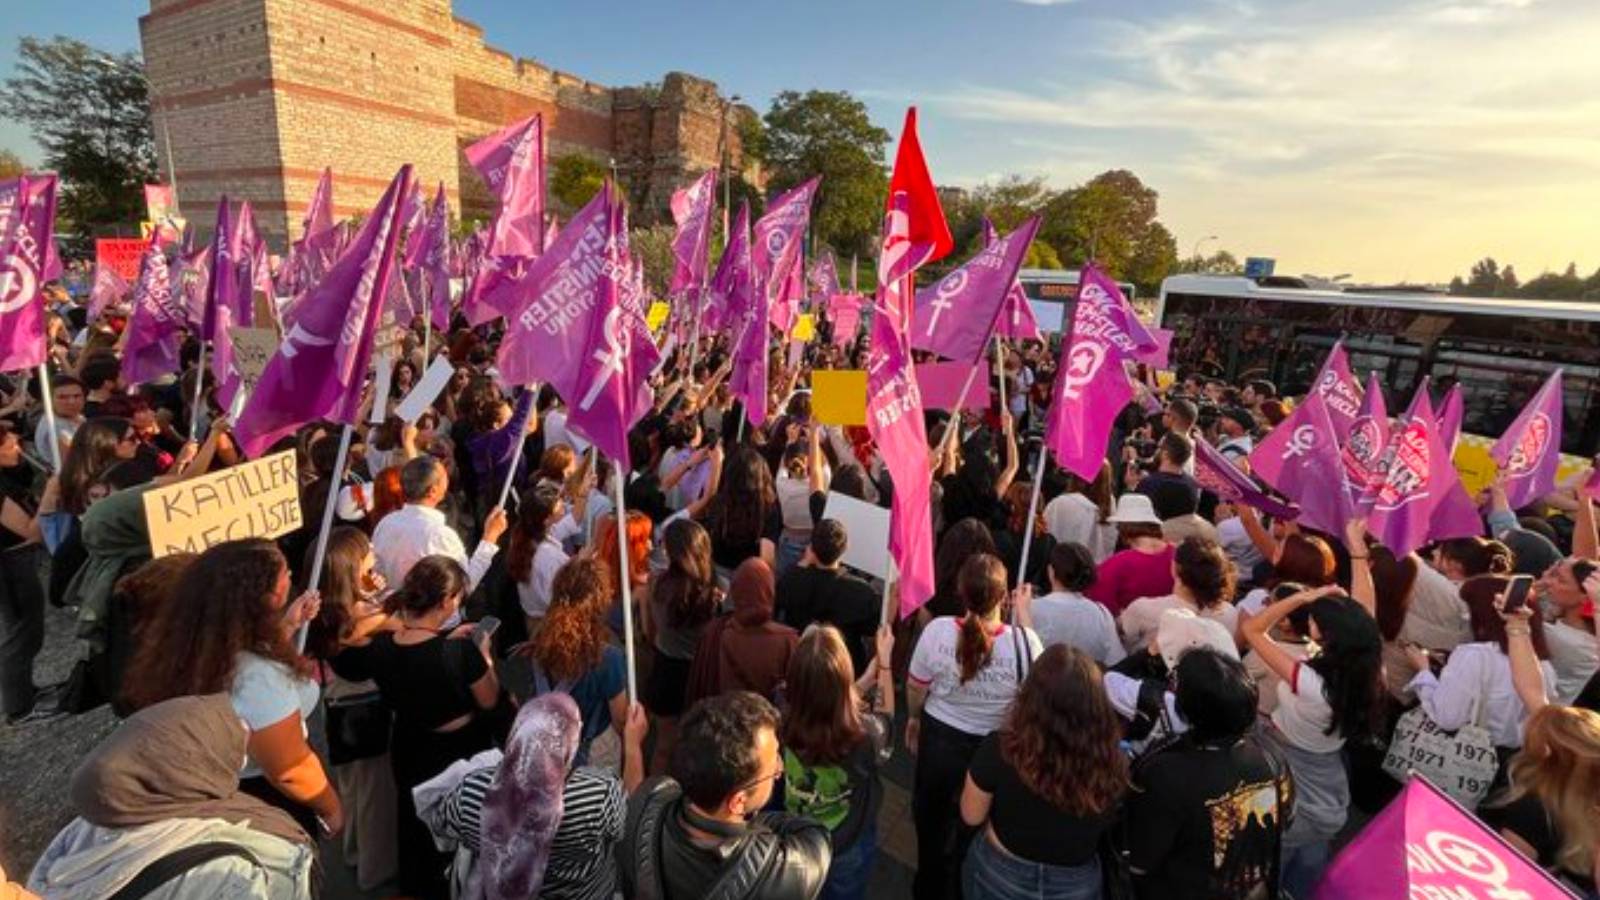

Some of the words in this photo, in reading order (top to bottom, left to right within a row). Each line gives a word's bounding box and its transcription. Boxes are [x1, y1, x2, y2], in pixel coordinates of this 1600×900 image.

[162, 455, 297, 522] KATİLLER
[1409, 746, 1445, 768] 1971
[1455, 742, 1496, 764] 1971
